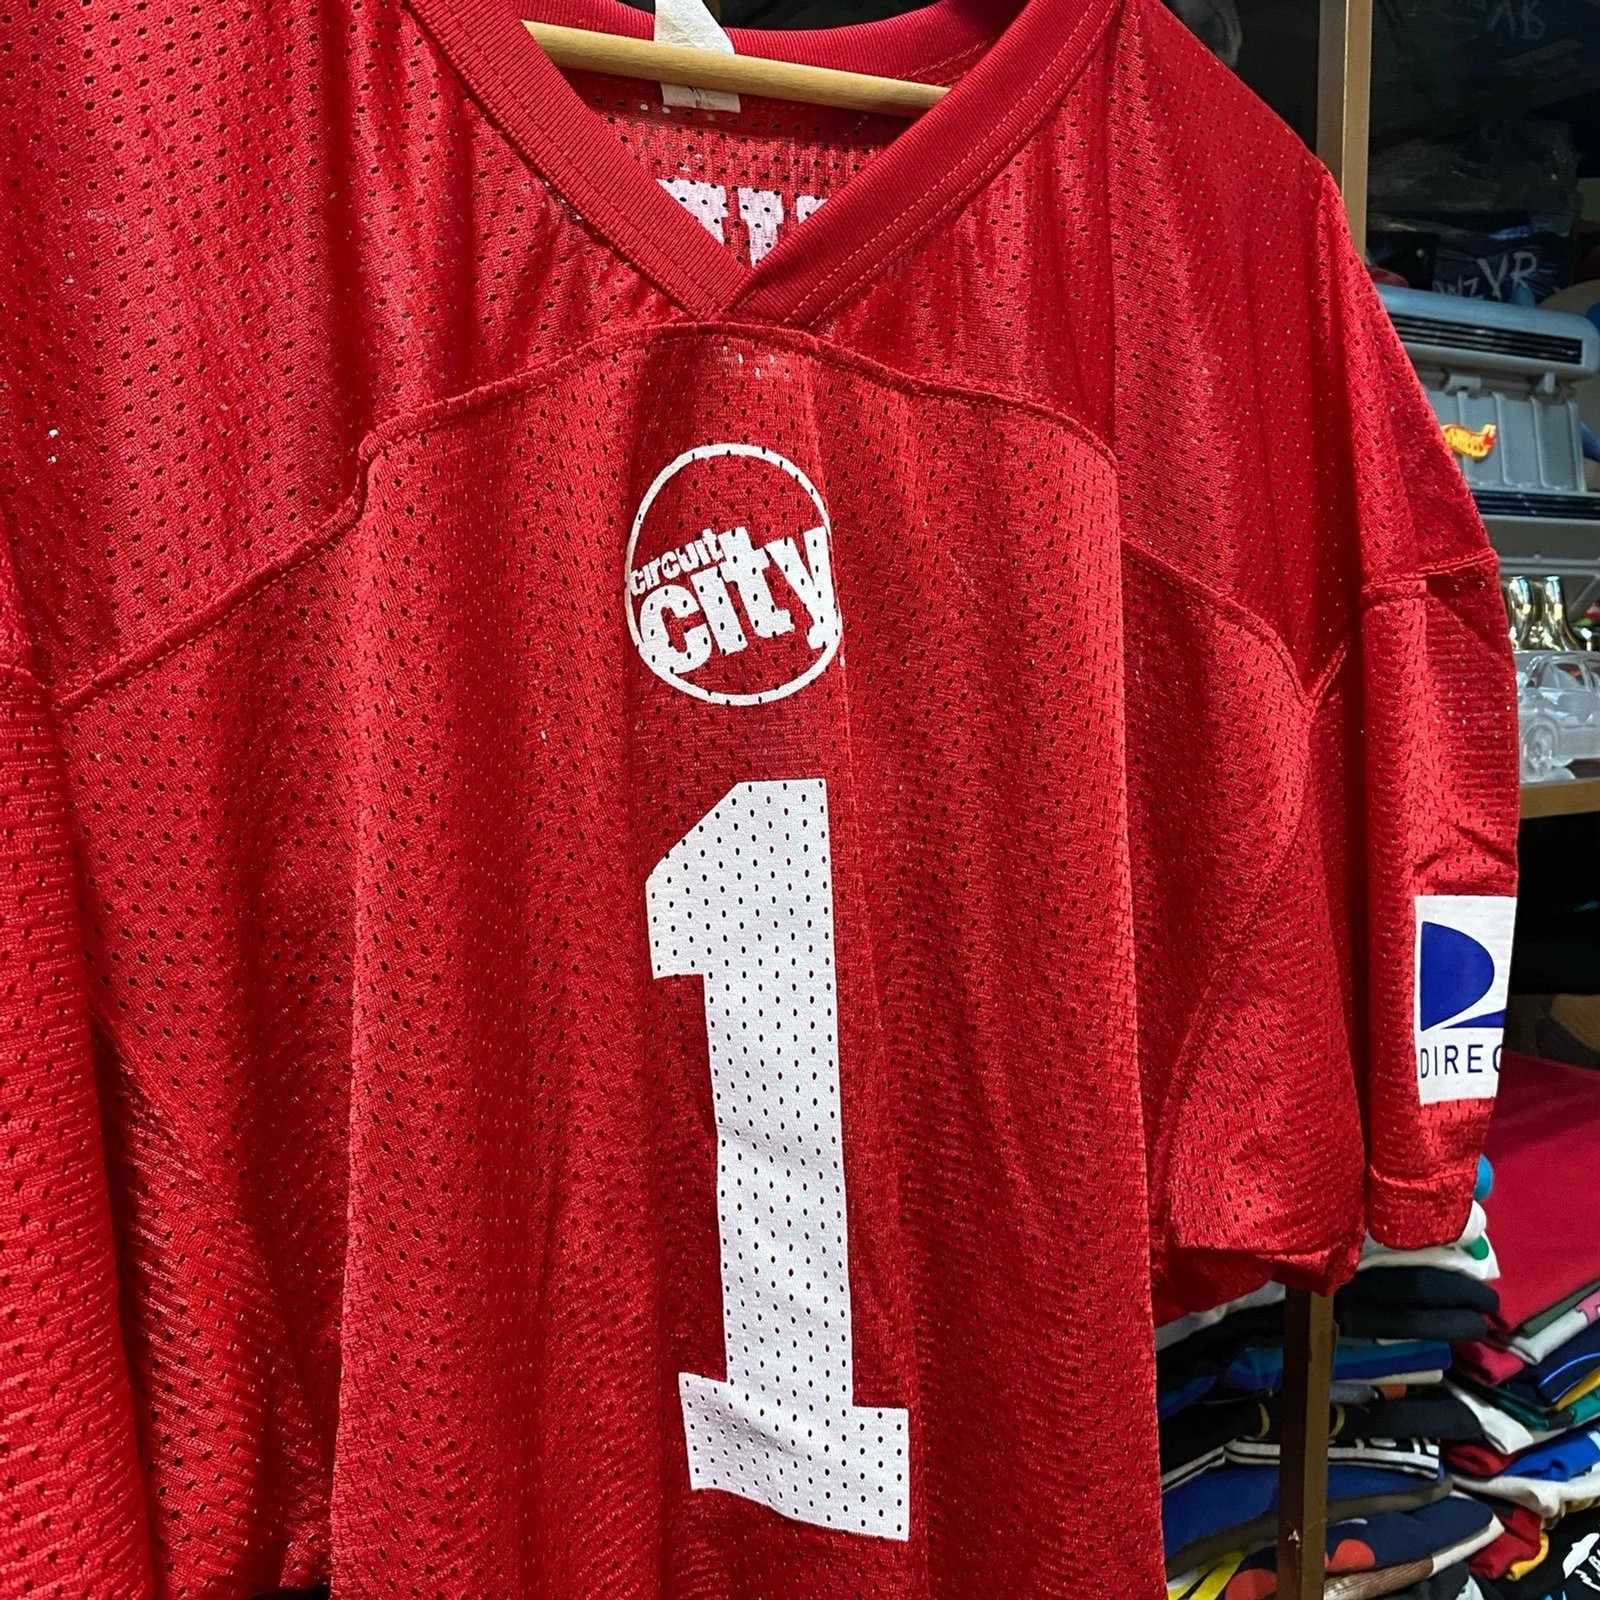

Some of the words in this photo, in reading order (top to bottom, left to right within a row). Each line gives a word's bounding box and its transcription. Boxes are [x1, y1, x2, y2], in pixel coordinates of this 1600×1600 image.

[630, 528, 725, 595] circuit
[640, 526, 838, 674] city
[646, 779, 909, 1541] 1
